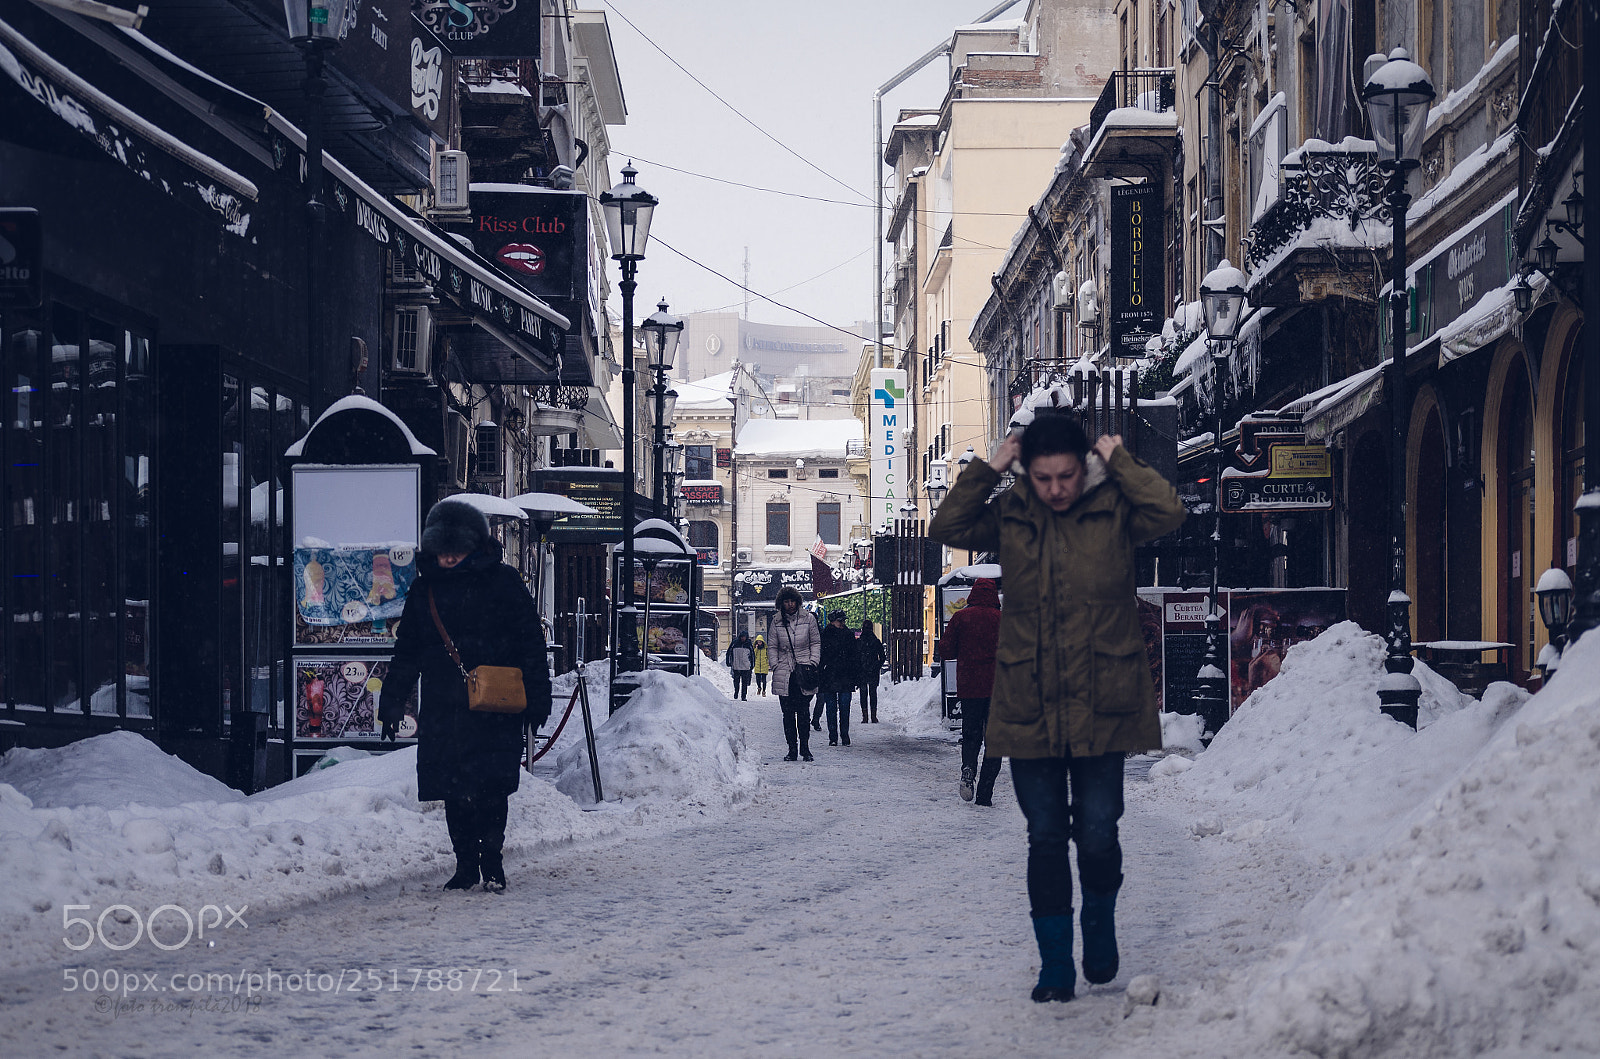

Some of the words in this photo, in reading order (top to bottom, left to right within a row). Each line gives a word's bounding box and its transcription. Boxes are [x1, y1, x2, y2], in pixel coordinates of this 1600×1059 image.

[448, 32, 474, 41] CLUB
[478, 215, 517, 234] Kiss
[522, 216, 565, 234] Club
[1131, 201, 1142, 306] BORDELLO
[520, 307, 542, 340] PARTY
[882, 414, 897, 529] MEDICARE
[684, 491, 720, 499] ASSAGE
[1173, 604, 1203, 612] CURTEA
[345, 667, 357, 677] 23
